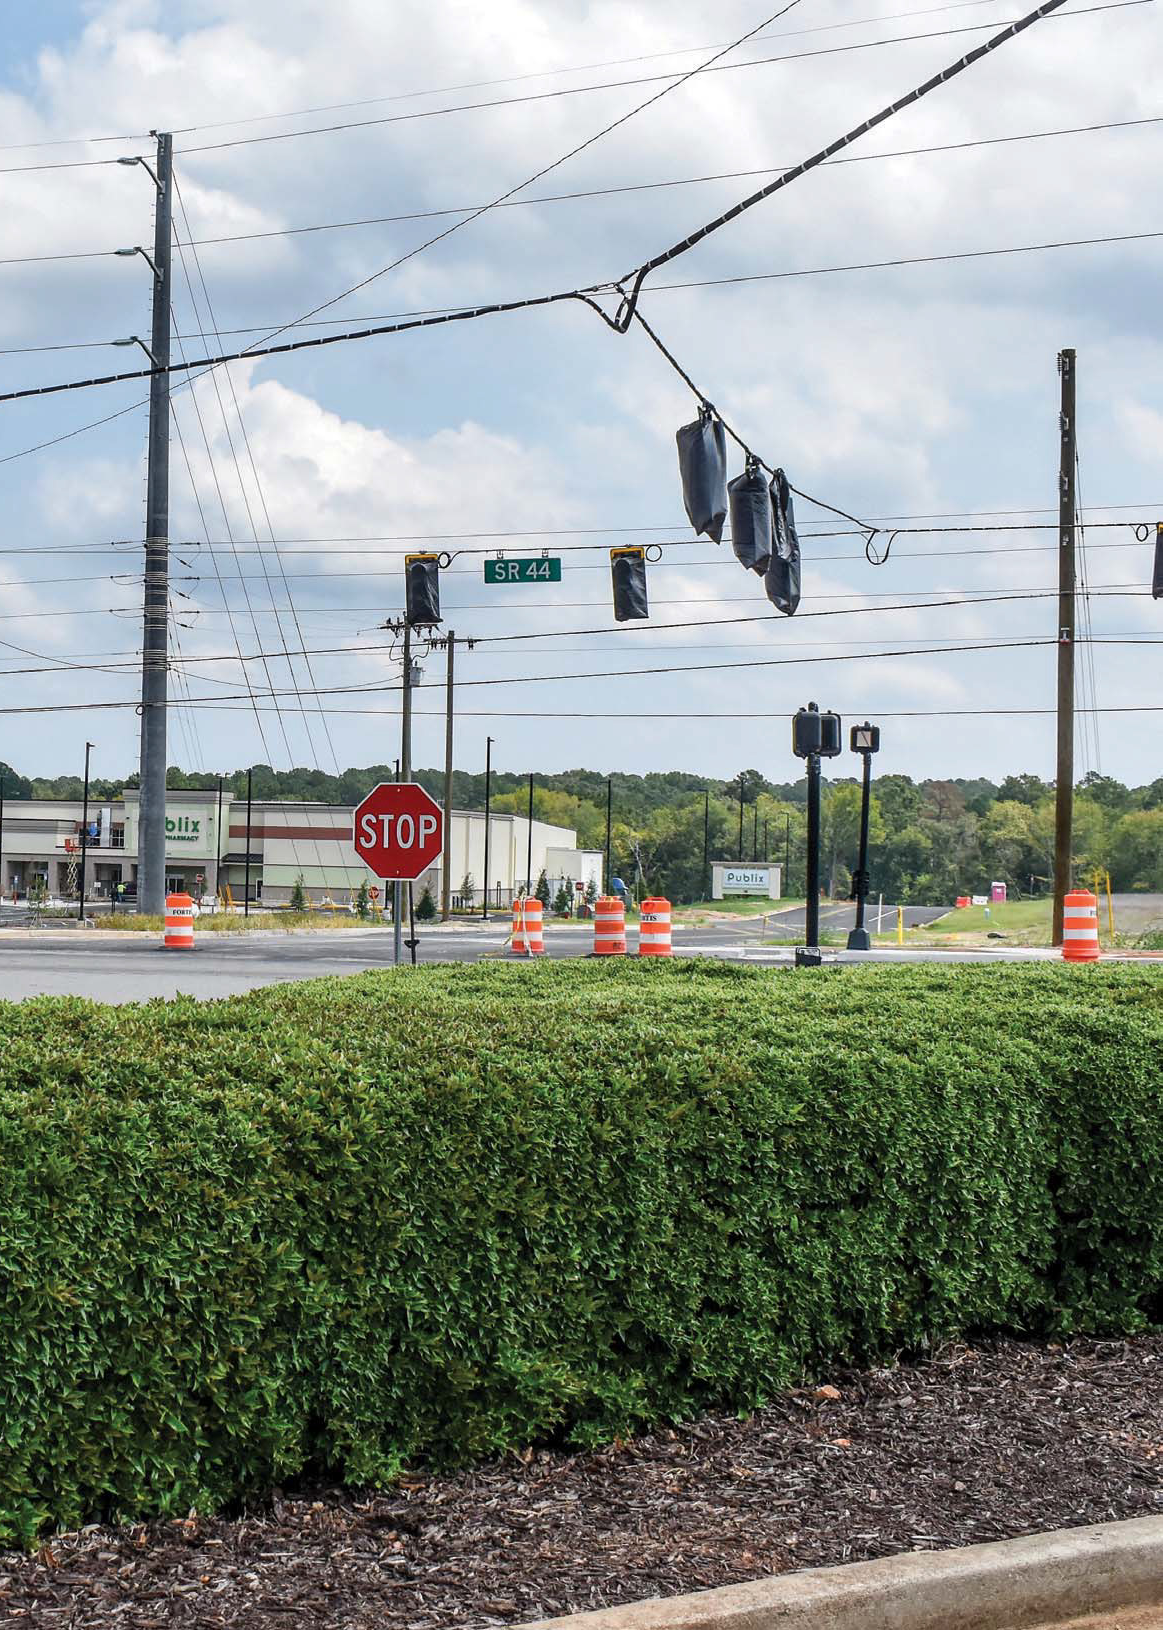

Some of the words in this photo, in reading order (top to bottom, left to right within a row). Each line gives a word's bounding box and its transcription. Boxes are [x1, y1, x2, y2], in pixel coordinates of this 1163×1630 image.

[494, 562, 520, 580] SR
[525, 561, 552, 579] 44
[165, 816, 200, 832] blix
[359, 814, 438, 849] STOP
[727, 872, 765, 883] Publix
